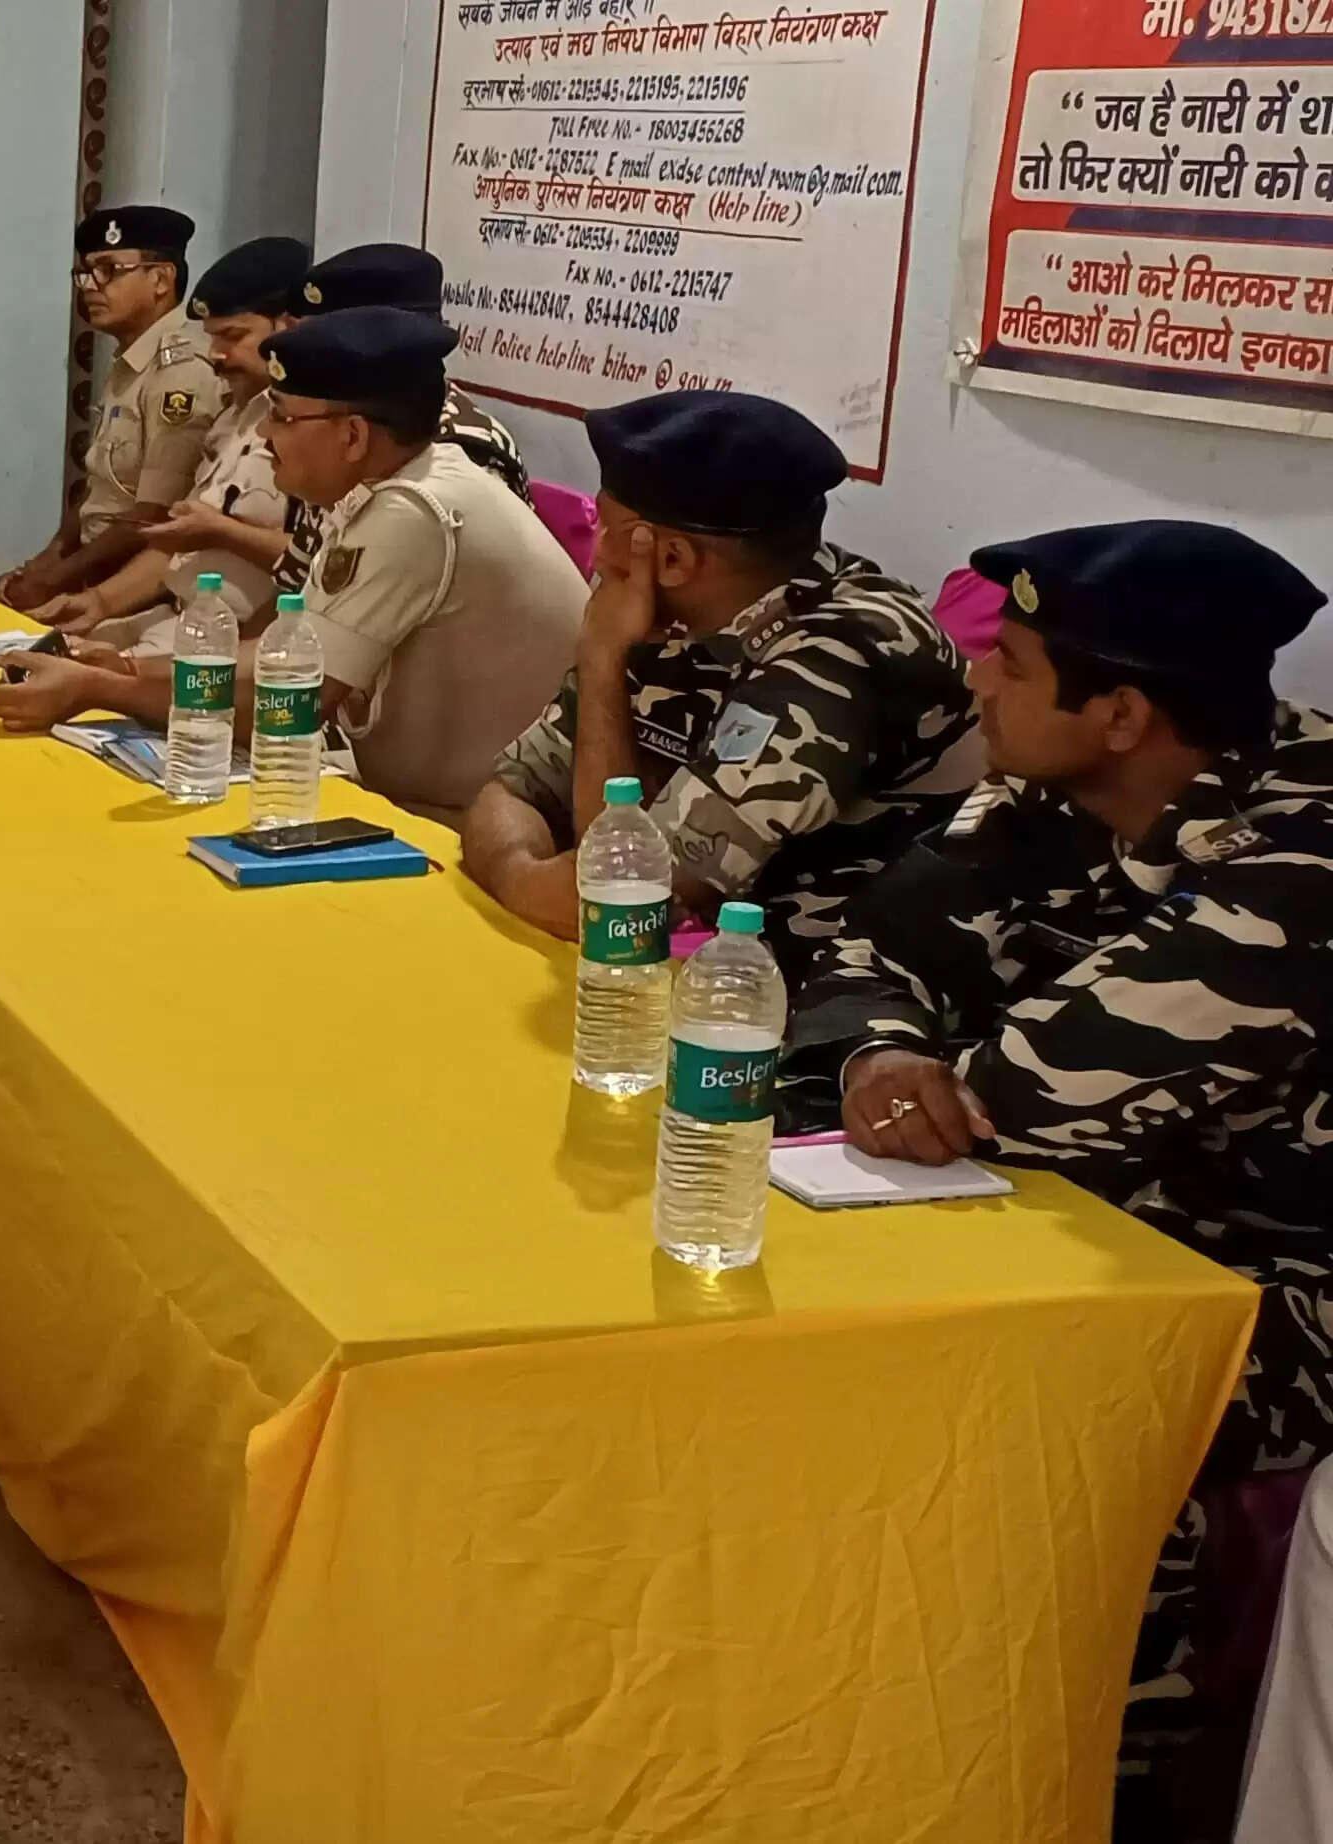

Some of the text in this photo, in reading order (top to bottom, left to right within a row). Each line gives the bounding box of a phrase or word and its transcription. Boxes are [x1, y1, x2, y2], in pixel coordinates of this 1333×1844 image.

[539, 27, 563, 61] एवं
[652, 14, 709, 55] विभाग
[841, 10, 889, 47] कक्ष
[1206, 0, 1333, 40] 943182
[648, 117, 745, 143] 18003456268
[1094, 96, 1146, 132] जब
[1149, 79, 1177, 137] है
[1181, 78, 1251, 134] नारी
[1255, 79, 1301, 135] में
[1019, 141, 1053, 190] तो
[1059, 140, 1116, 194] फिर
[1117, 143, 1181, 195] क्यों
[1179, 143, 1249, 199] नारी
[1254, 146, 1309, 201] को
[535, 171, 584, 213] पुलिस
[653, 188, 696, 224] कक्ष
[624, 228, 680, 257] 2209999
[630, 268, 734, 302] 0612-2215747
[1067, 251, 1133, 296] आओ
[1181, 254, 1301, 311] मिलकर
[585, 295, 681, 334] 8544428408
[1001, 295, 1109, 349] महिलाओं
[1106, 307, 1141, 353] को
[491, 328, 532, 363] Police
[601, 343, 647, 383] bihar
